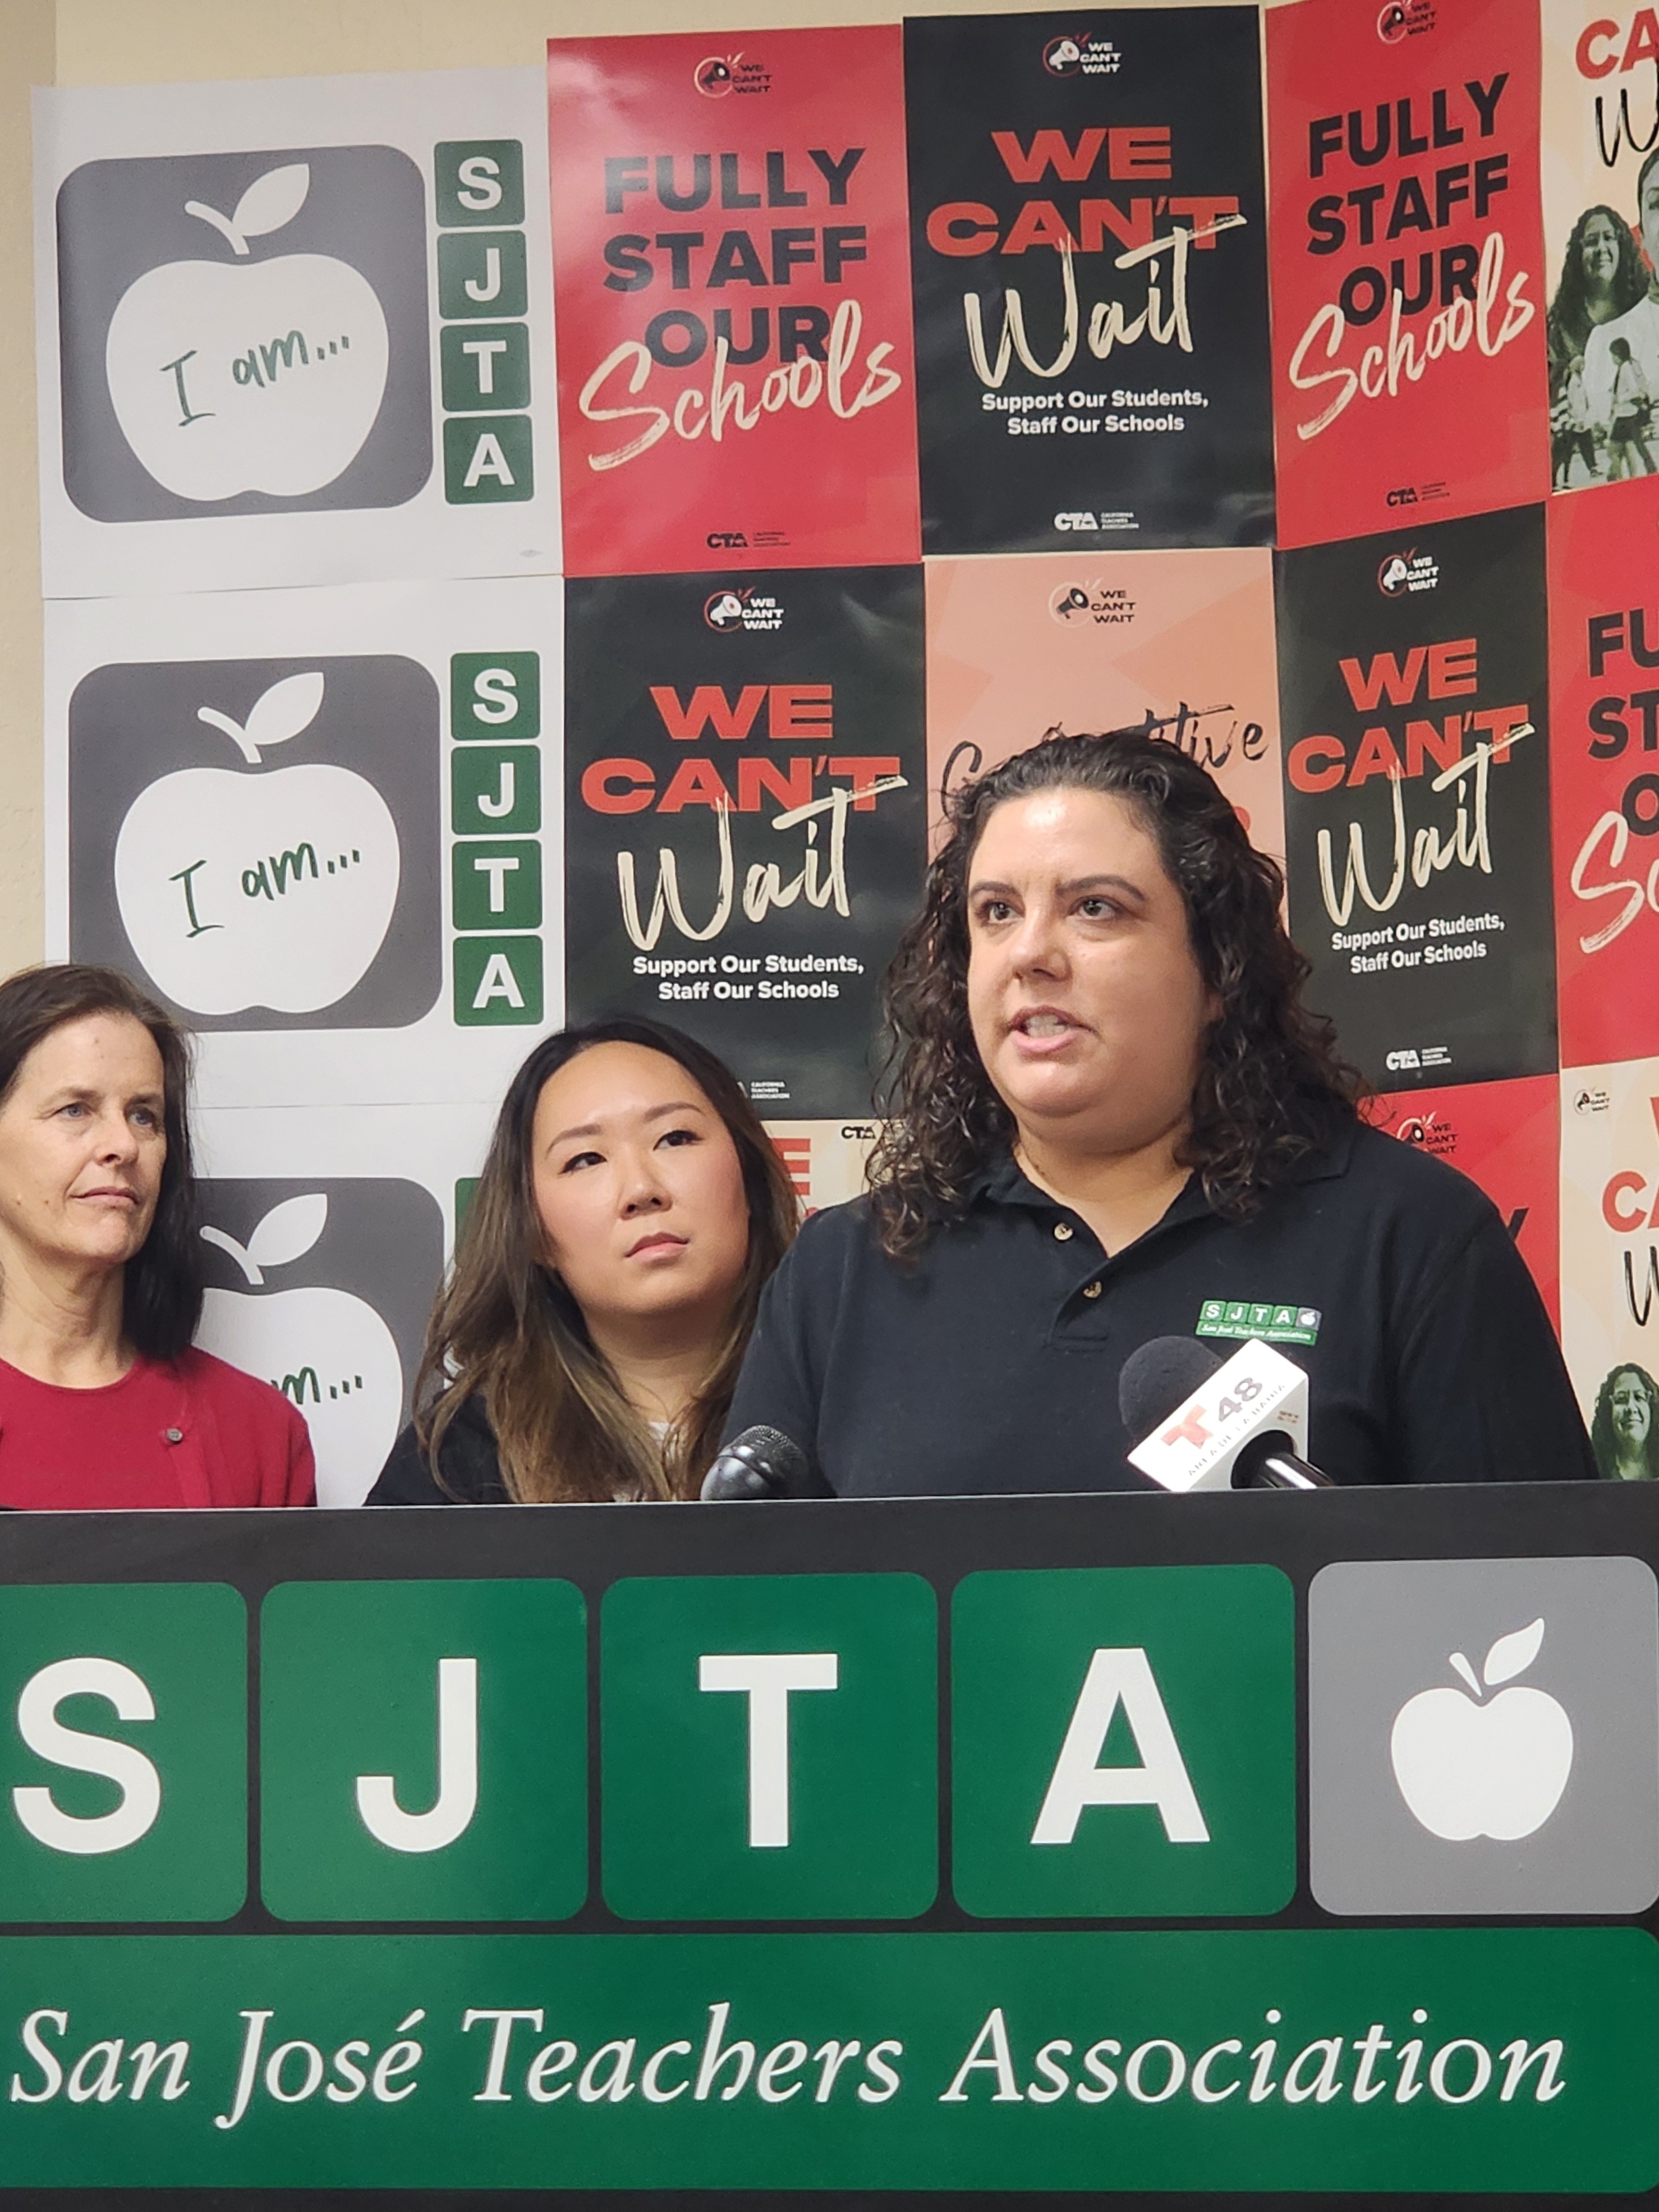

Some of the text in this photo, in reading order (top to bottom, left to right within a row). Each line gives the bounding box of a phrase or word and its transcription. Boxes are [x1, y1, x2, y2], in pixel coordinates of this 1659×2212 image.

[1088, 42, 1113, 52] WE
[1082, 63, 1120, 74] WAIT
[1309, 72, 1510, 179] FULLY
[991, 127, 1172, 183] WE
[604, 148, 867, 214] FULLY
[1306, 153, 1509, 256] STAFF
[926, 196, 1239, 256] CAN'T
[603, 226, 867, 292] STAFF
[963, 213, 1248, 388] Wait
[1339, 243, 1480, 327] OUR
[645, 305, 833, 368] OUR
[1289, 232, 1536, 441] Schools
[159, 350, 216, 426] I
[579, 299, 902, 471] Schools
[982, 389, 1208, 414] Support Our Students,
[1008, 414, 1185, 435] Staff Our Schools
[1386, 487, 1418, 507] CTA
[707, 533, 748, 549] CTA
[1054, 512, 1099, 531] CTA
[1413, 557, 1432, 568] WE
[750, 598, 775, 607] WE
[1100, 590, 1126, 599] WE
[1408, 577, 1438, 591] WAIT
[743, 620, 783, 630] WAIT
[1093, 614, 1134, 623] WAIT
[1340, 638, 1477, 711] WE
[649, 685, 834, 740] WE
[1288, 704, 1529, 793] CAN'T
[580, 756, 900, 815] CAN'T
[1318, 723, 1536, 927] Wait
[617, 775, 909, 952] Wait
[169, 860, 224, 938] I
[1332, 913, 1505, 952] Support Our Students,
[633, 954, 864, 977] Support Our Students,
[1350, 940, 1487, 974] Staff Our Schools
[659, 980, 840, 1000] Staff Our Schools
[1386, 1050, 1421, 1070] CTA
[842, 1126, 876, 1139] CTA
[1432, 1123, 1451, 1132] WE
[1206, 1304, 1290, 1323] SJTA
[1219, 1377, 1263, 1422] 48
[10, 2001, 1567, 2131] San José Teachers Association
